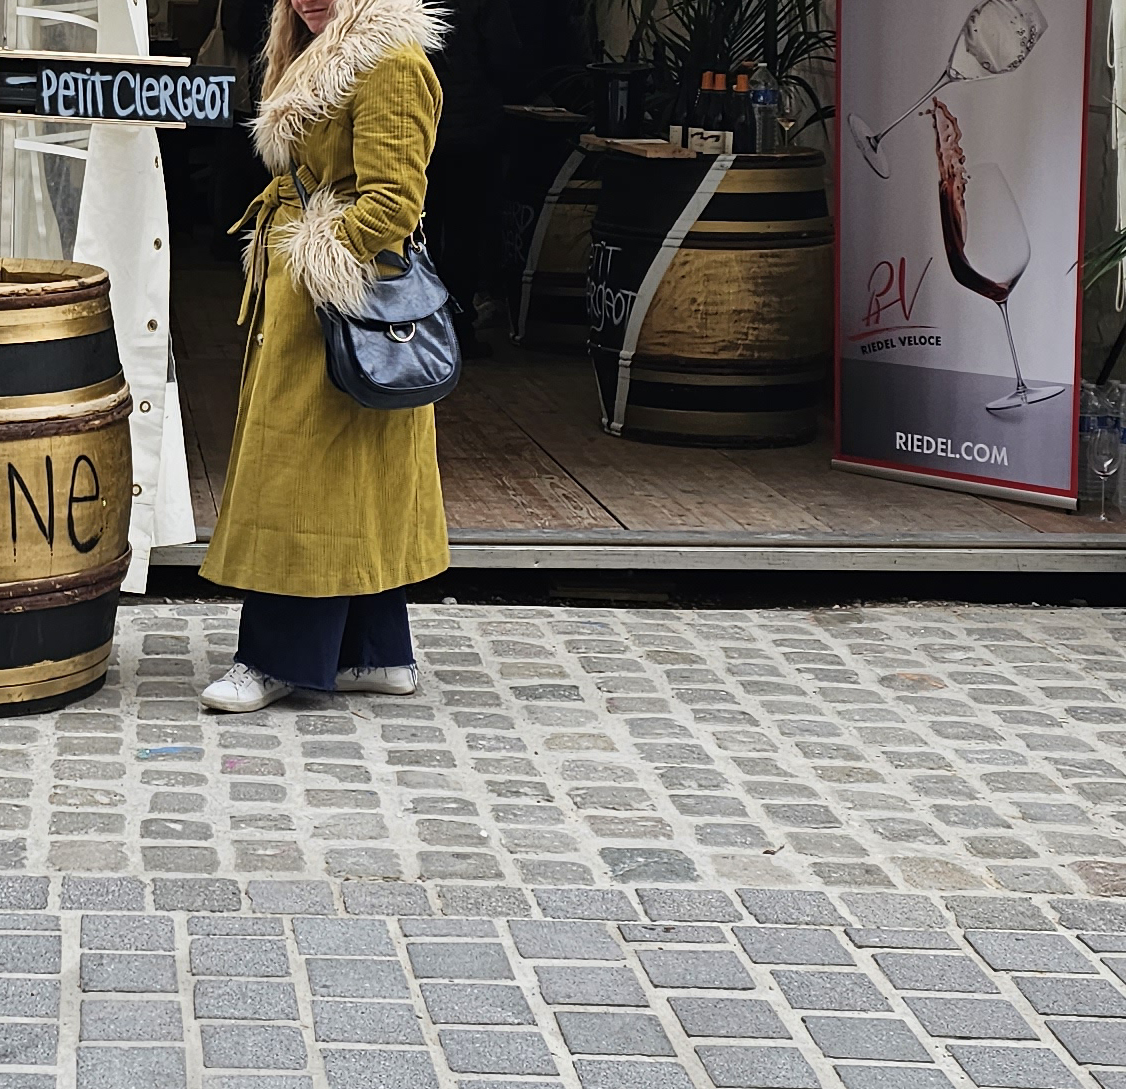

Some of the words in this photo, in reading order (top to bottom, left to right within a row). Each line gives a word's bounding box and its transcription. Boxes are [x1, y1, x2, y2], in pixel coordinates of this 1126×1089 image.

[861, 338, 896, 355] RIEDEL
[898, 335, 942, 347] VELOCE
[896, 431, 1008, 466] RIEDEL.COM
